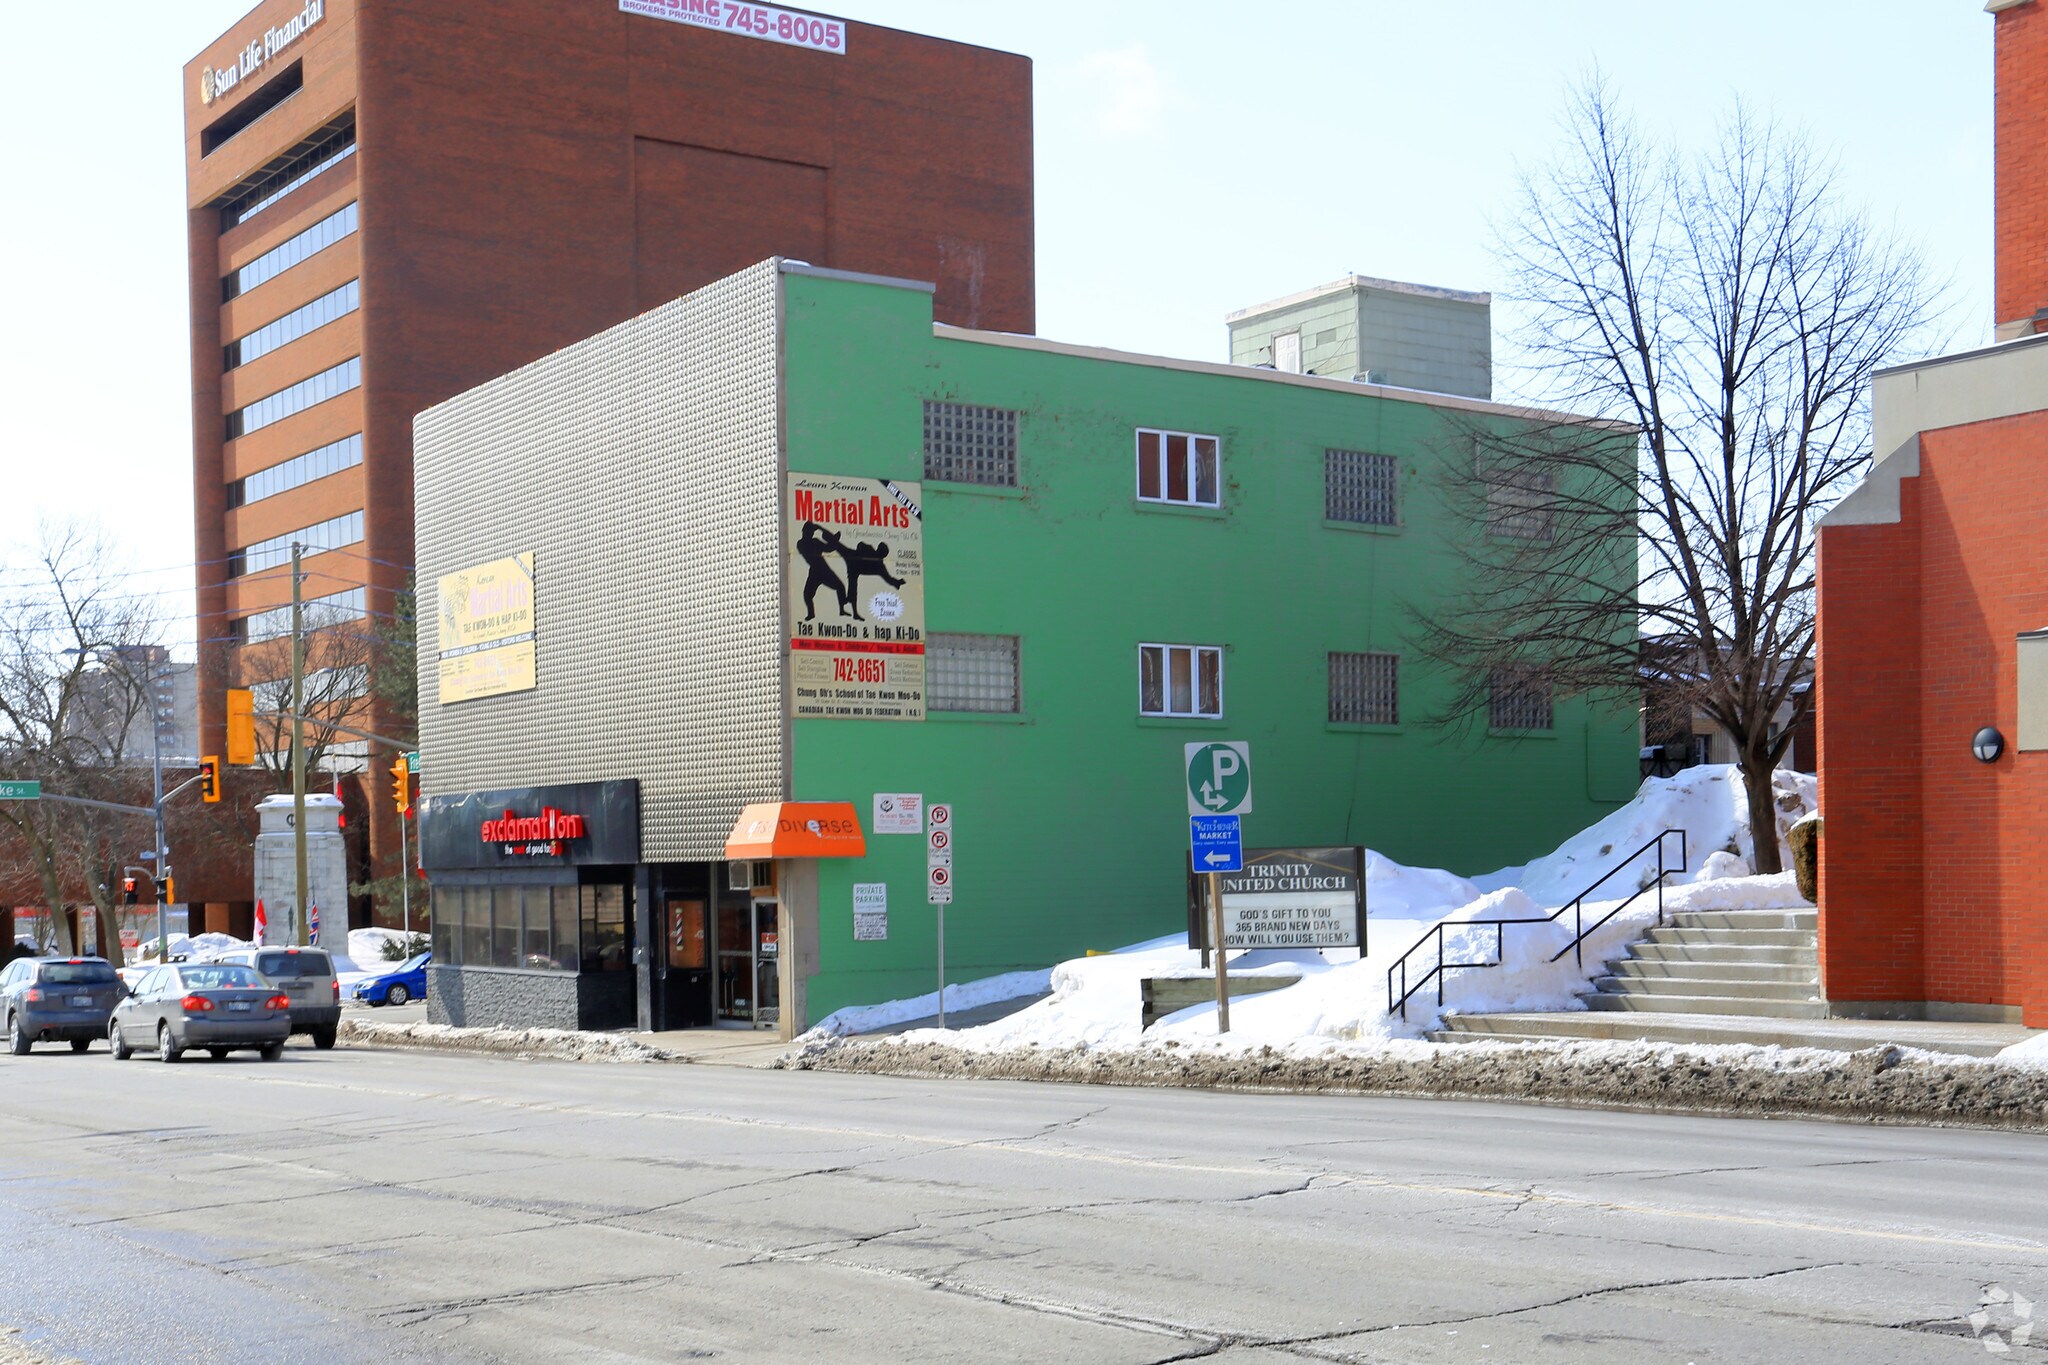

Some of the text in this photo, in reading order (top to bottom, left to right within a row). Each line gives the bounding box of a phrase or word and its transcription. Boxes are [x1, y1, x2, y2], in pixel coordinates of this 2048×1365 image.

[623, 1, 720, 26] BROKERS PROTECTED
[723, 3, 840, 48] 745-8005
[215, 0, 324, 98] Sun Life Financial
[795, 480, 868, 492] Learn Korean
[795, 489, 864, 526] Martial
[868, 495, 909, 529] Arts
[797, 621, 920, 641] Tae Kwon-Do & hap Ki-Do
[833, 658, 885, 683] 742-8651
[797, 687, 817, 698] Chung
[835, 689, 856, 699] School
[858, 690, 863, 698] of
[866, 690, 876, 699] Tae
[879, 690, 895, 700] Kwon
[798, 705, 823, 714] CANADIAN
[826, 706, 834, 714] TAE
[874, 708, 902, 716] FEDERATION
[1199, 832, 1232, 840] MARKET
[1247, 864, 1313, 877] TRINITY
[1278, 876, 1346, 890] CHURCH
[856, 886, 883, 894] PRIVATE
[1240, 908, 1332, 919] GOD'S GIFT TO YOU
[1236, 920, 1340, 932] 365 BRAND NEW DAYS
[1247, 933, 1272, 944] WILL
[1275, 933, 1294, 943] YOU
[1296, 932, 1313, 943] USE
[1316, 931, 1349, 943] THEM?
